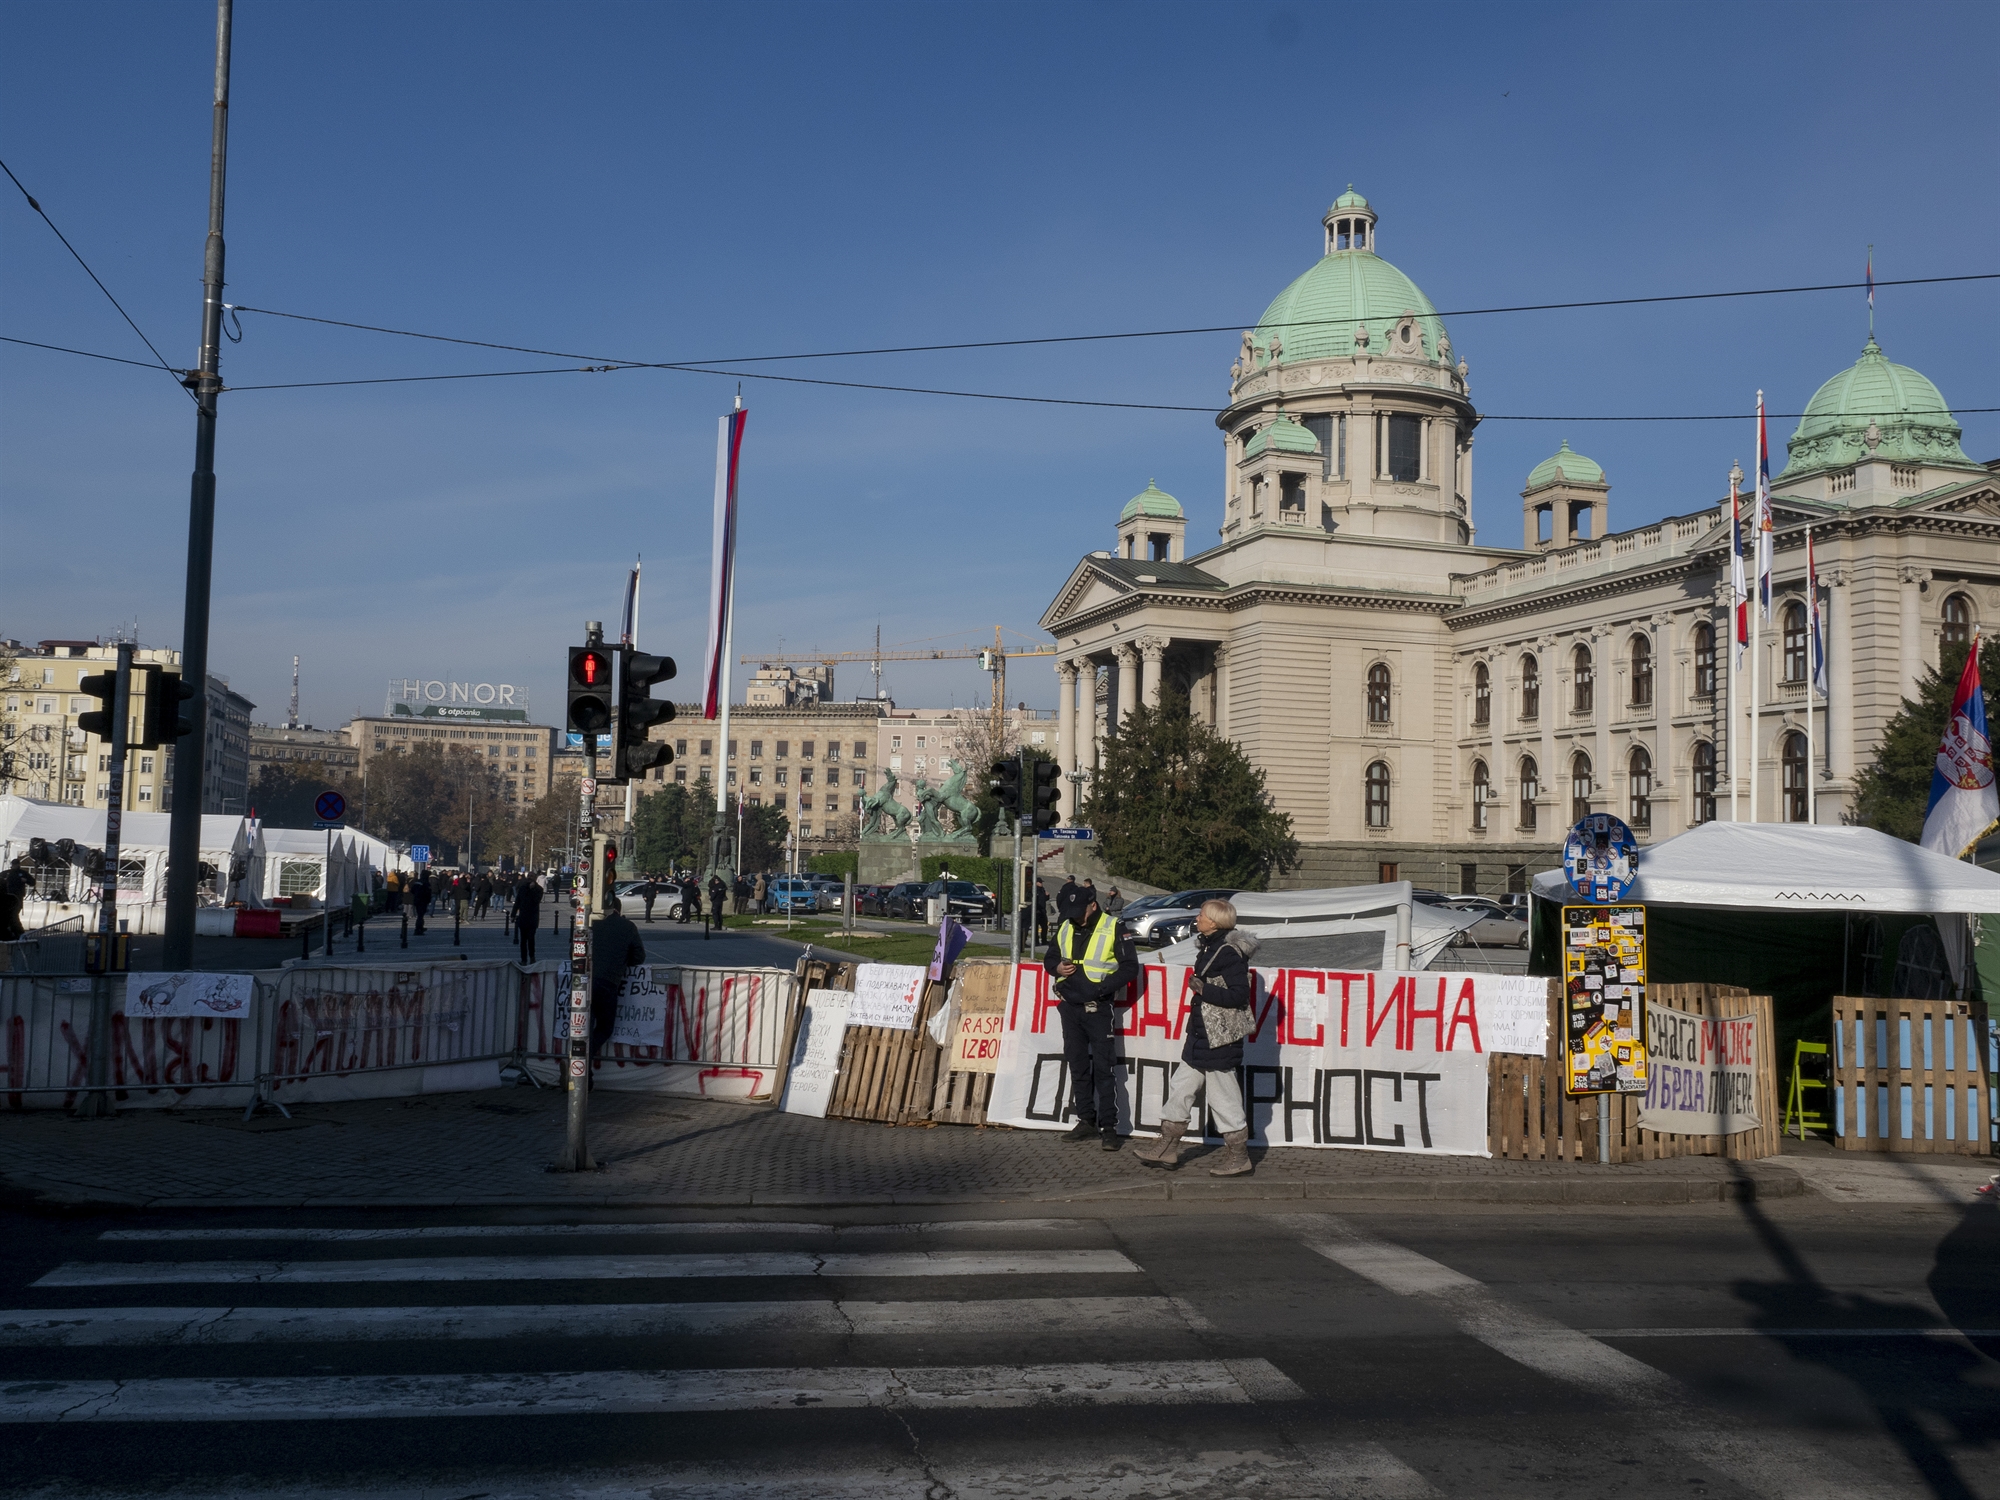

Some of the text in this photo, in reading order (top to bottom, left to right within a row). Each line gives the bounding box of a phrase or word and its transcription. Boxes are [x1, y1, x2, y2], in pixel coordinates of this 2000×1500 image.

[403, 678, 515, 705] HONOR
[448, 707, 480, 716] otpbanka
[1527, 980, 1543, 993] ДА
[895, 1016, 913, 1024] ИСТИ
[1248, 968, 1482, 1053] ИСТИНА
[1700, 1019, 1753, 1066] МАЈКЕ
[1660, 1065, 1705, 1112] БРДА
